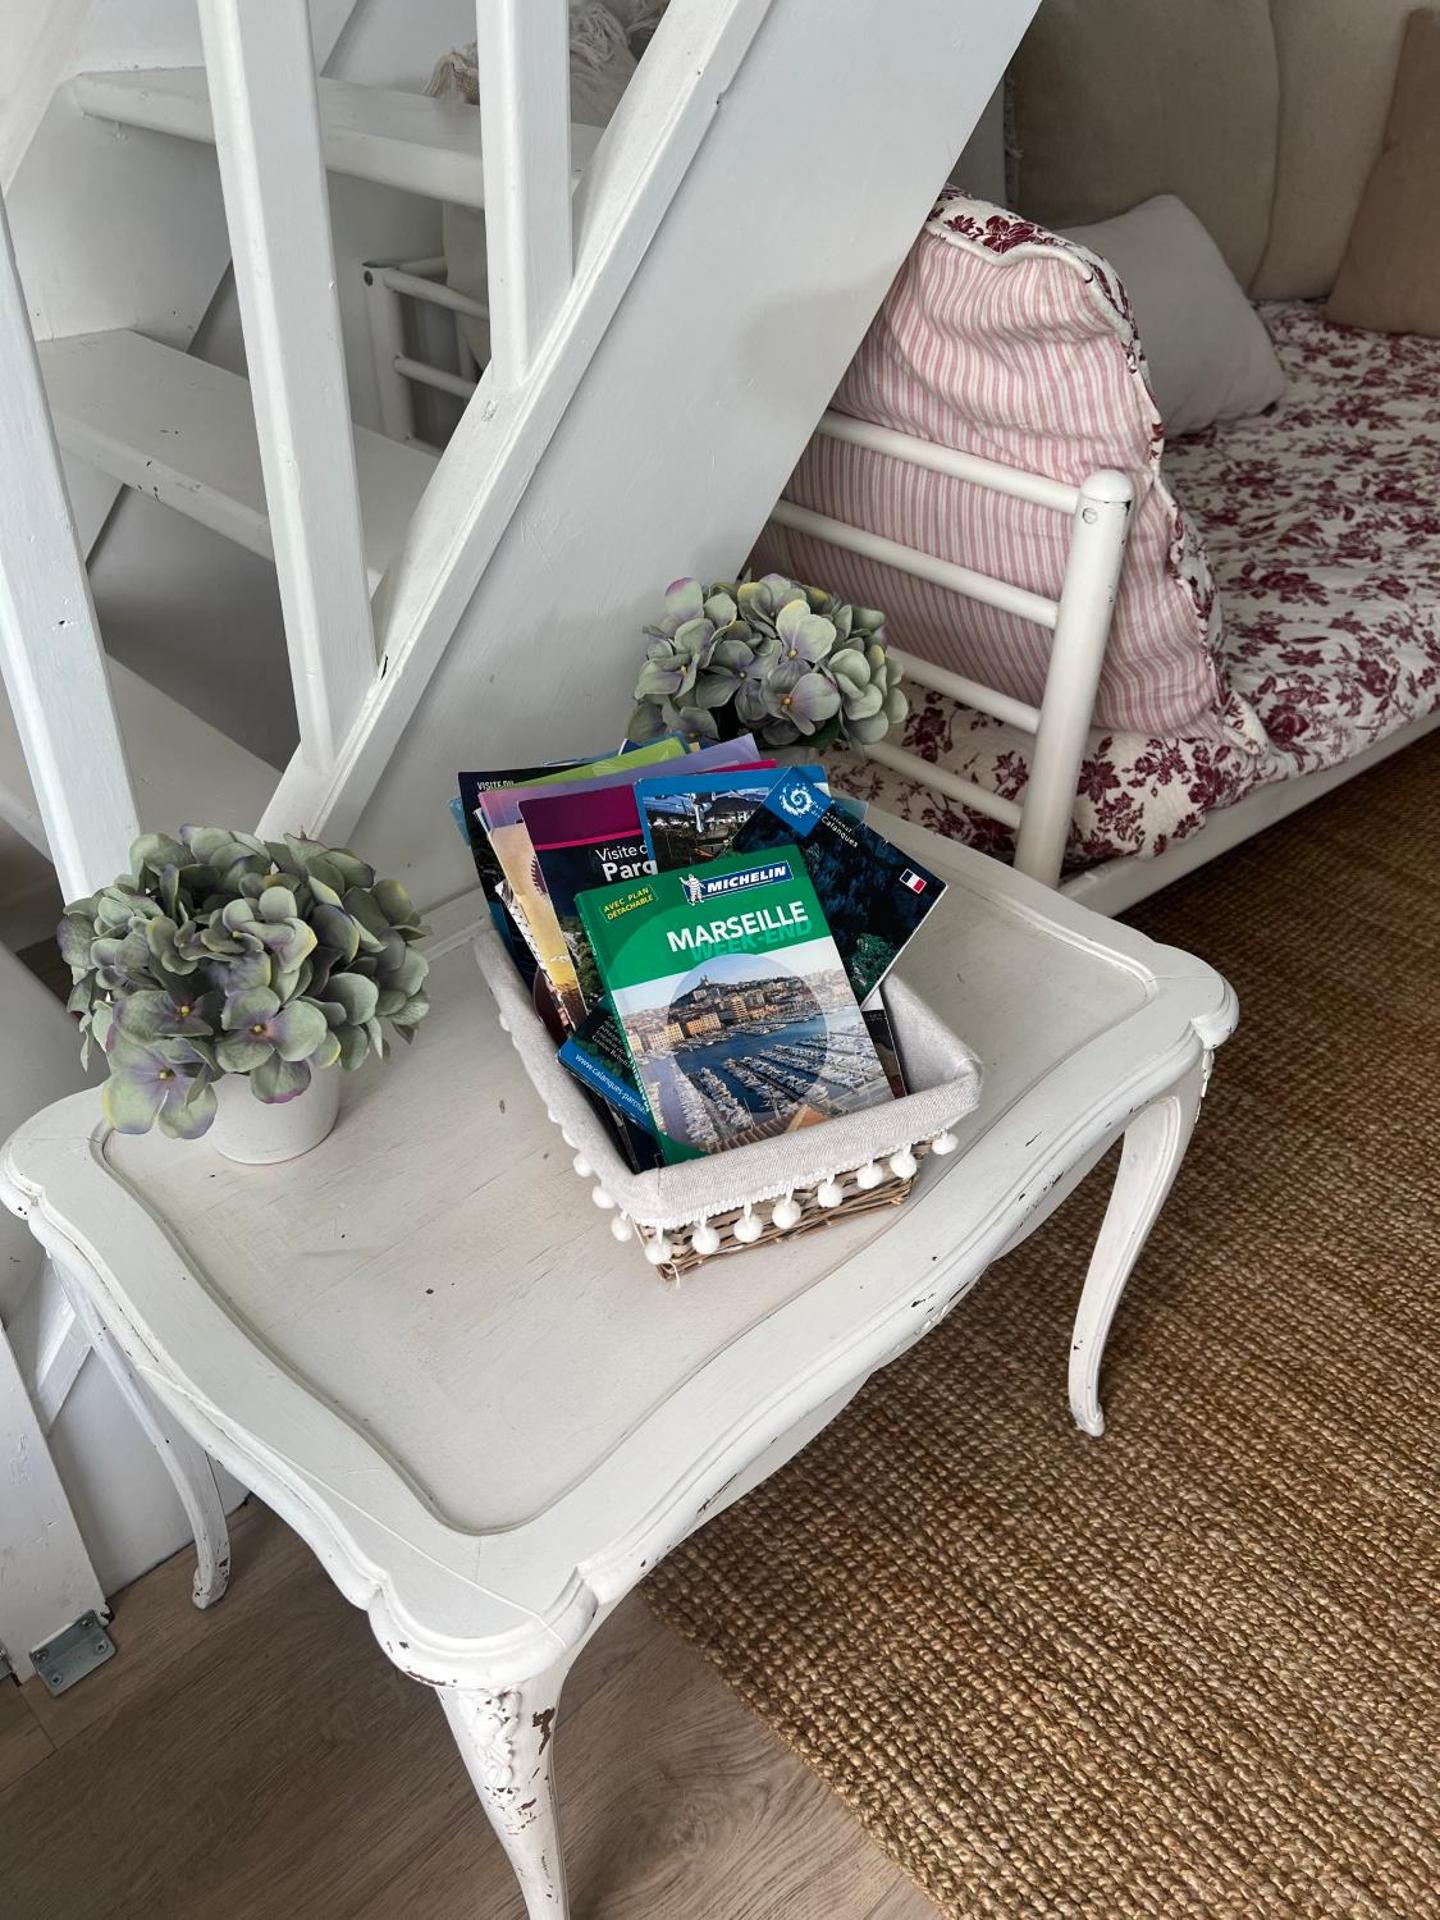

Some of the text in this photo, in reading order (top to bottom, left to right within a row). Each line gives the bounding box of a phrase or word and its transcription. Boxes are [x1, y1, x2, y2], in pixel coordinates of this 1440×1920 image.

[821, 815, 859, 848] Calanques
[595, 845, 638, 862] Visite
[707, 865, 787, 894] MICHELIN
[603, 887, 649, 912] AVEC PLAN
[666, 900, 809, 953] MARSEILLE
[689, 920, 813, 961] WEEK-END
[575, 1054, 647, 1114] www.calanques-parcna
